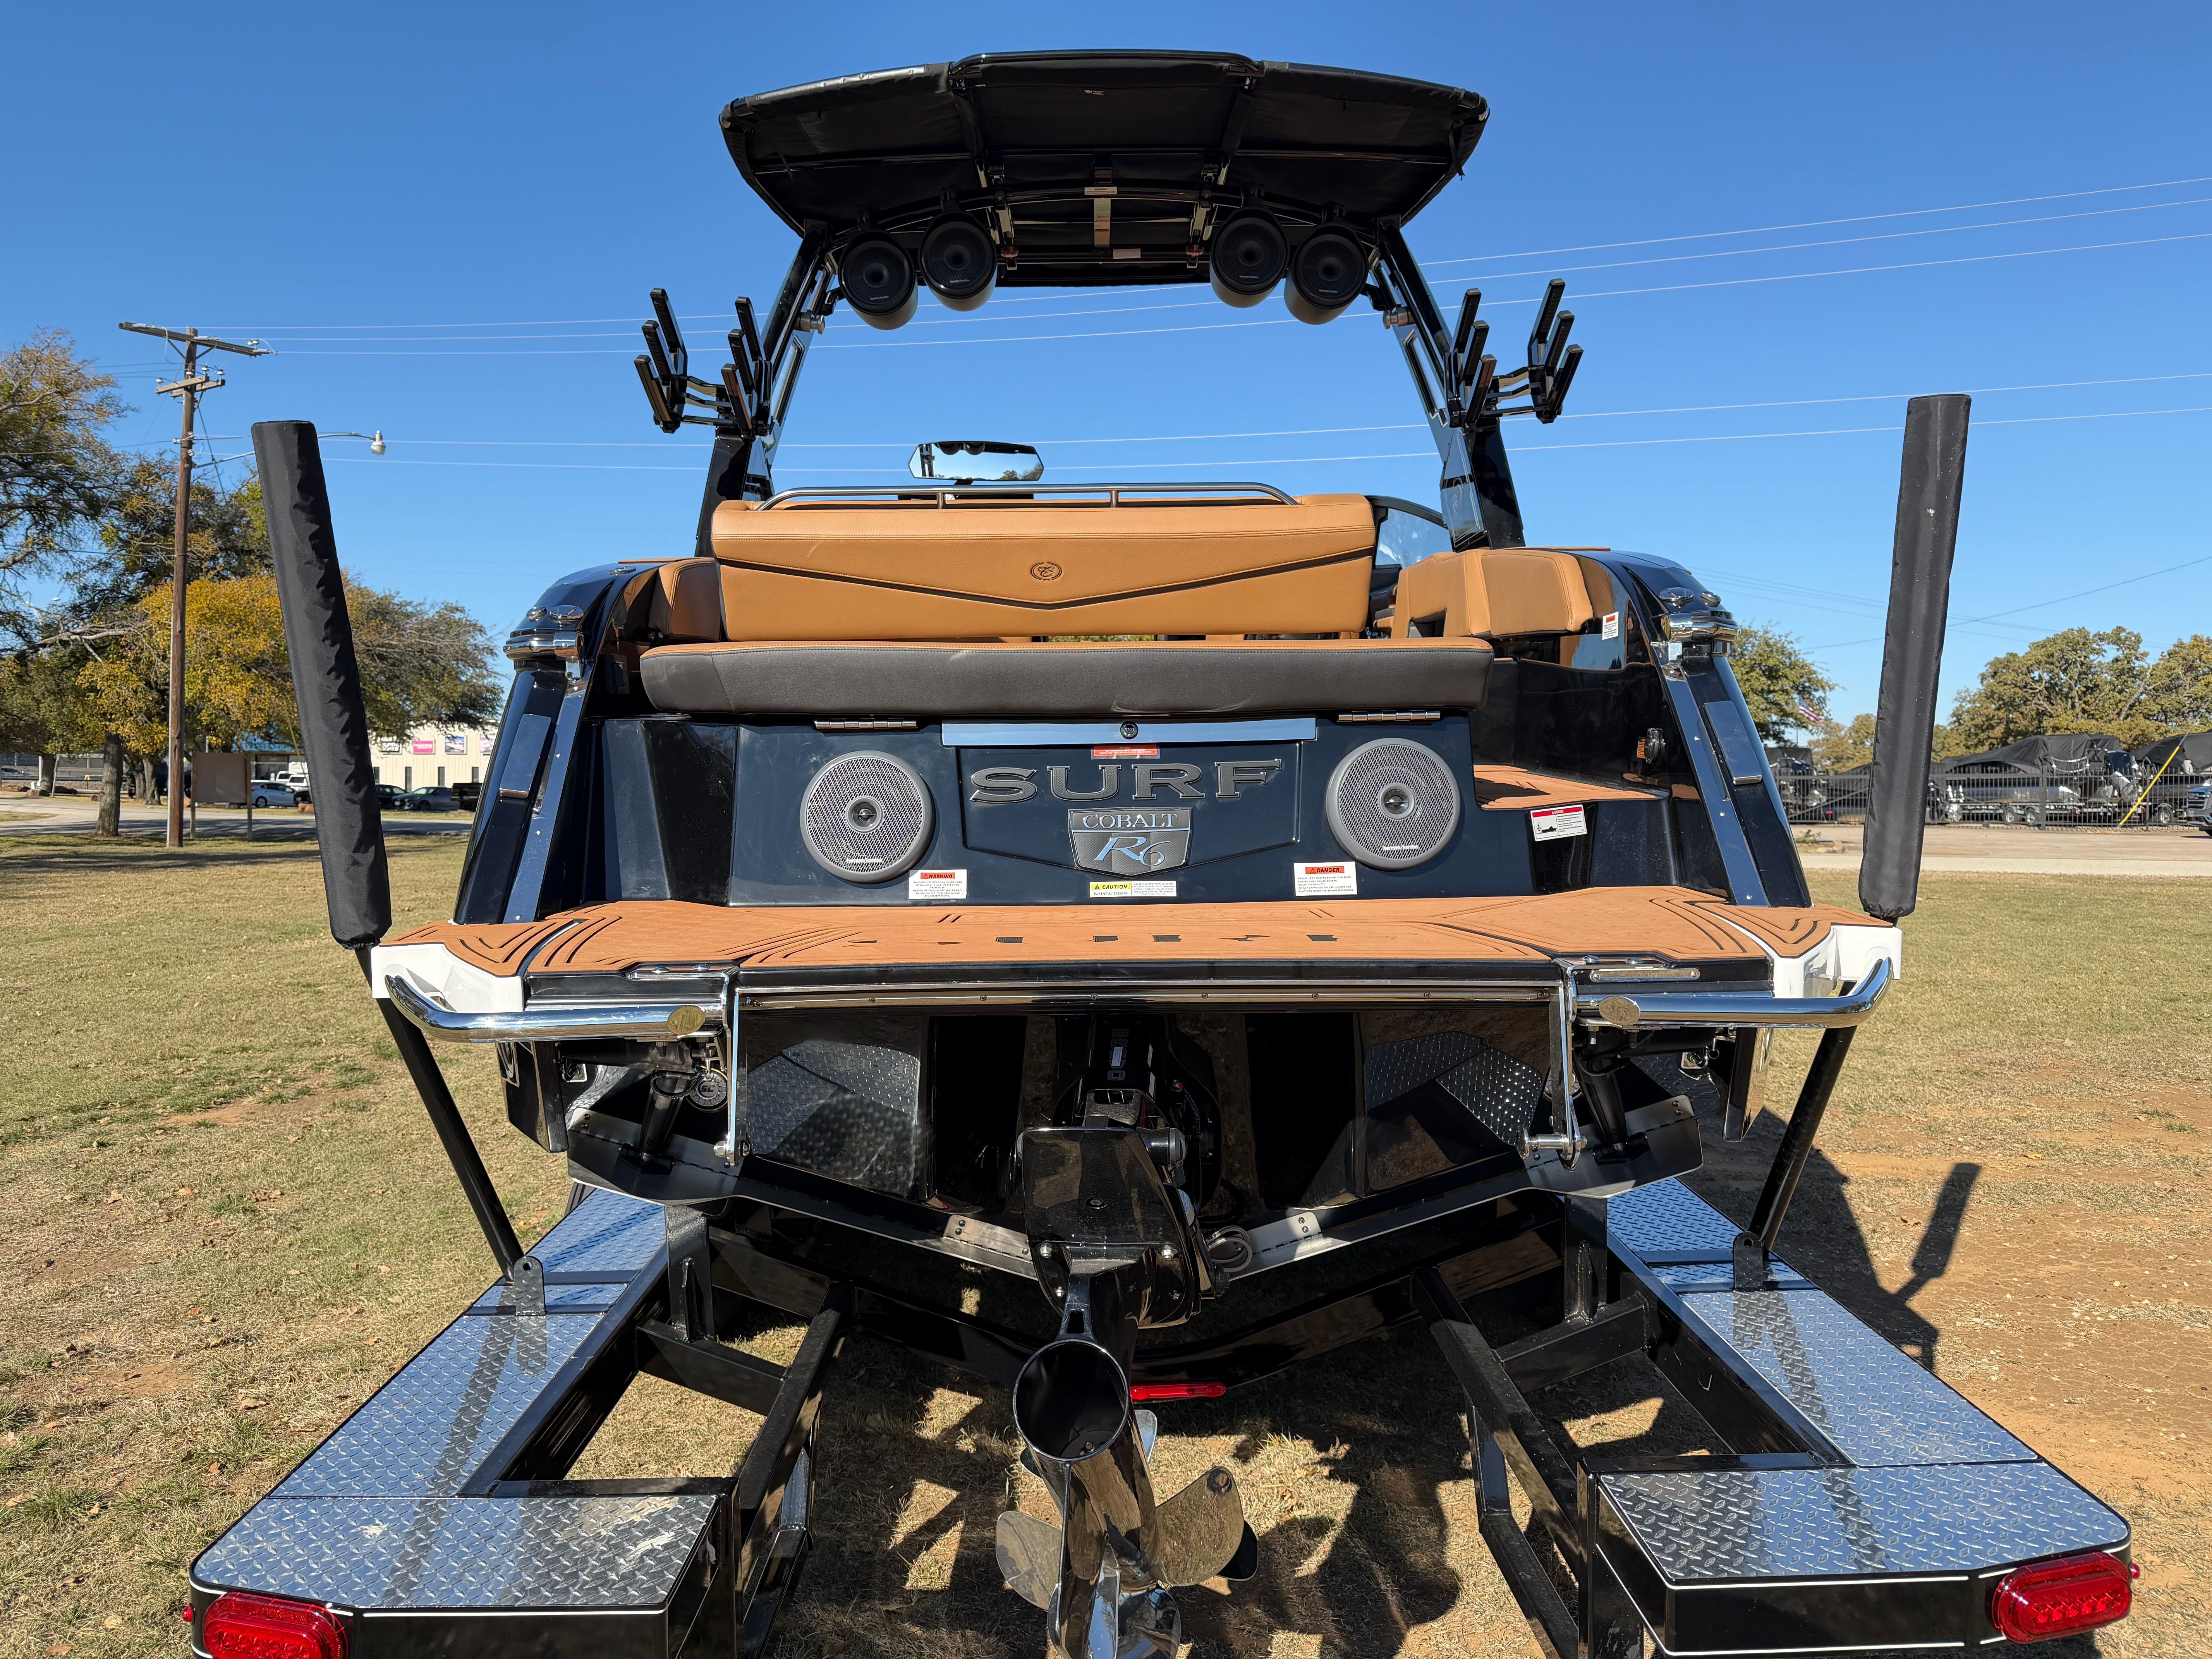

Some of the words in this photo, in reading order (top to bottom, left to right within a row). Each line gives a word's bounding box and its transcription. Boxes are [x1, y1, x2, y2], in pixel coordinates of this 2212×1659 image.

[970, 758, 1282, 803] SURF
[1083, 813, 1178, 828] COBALT
[1093, 837, 1171, 866] R6
